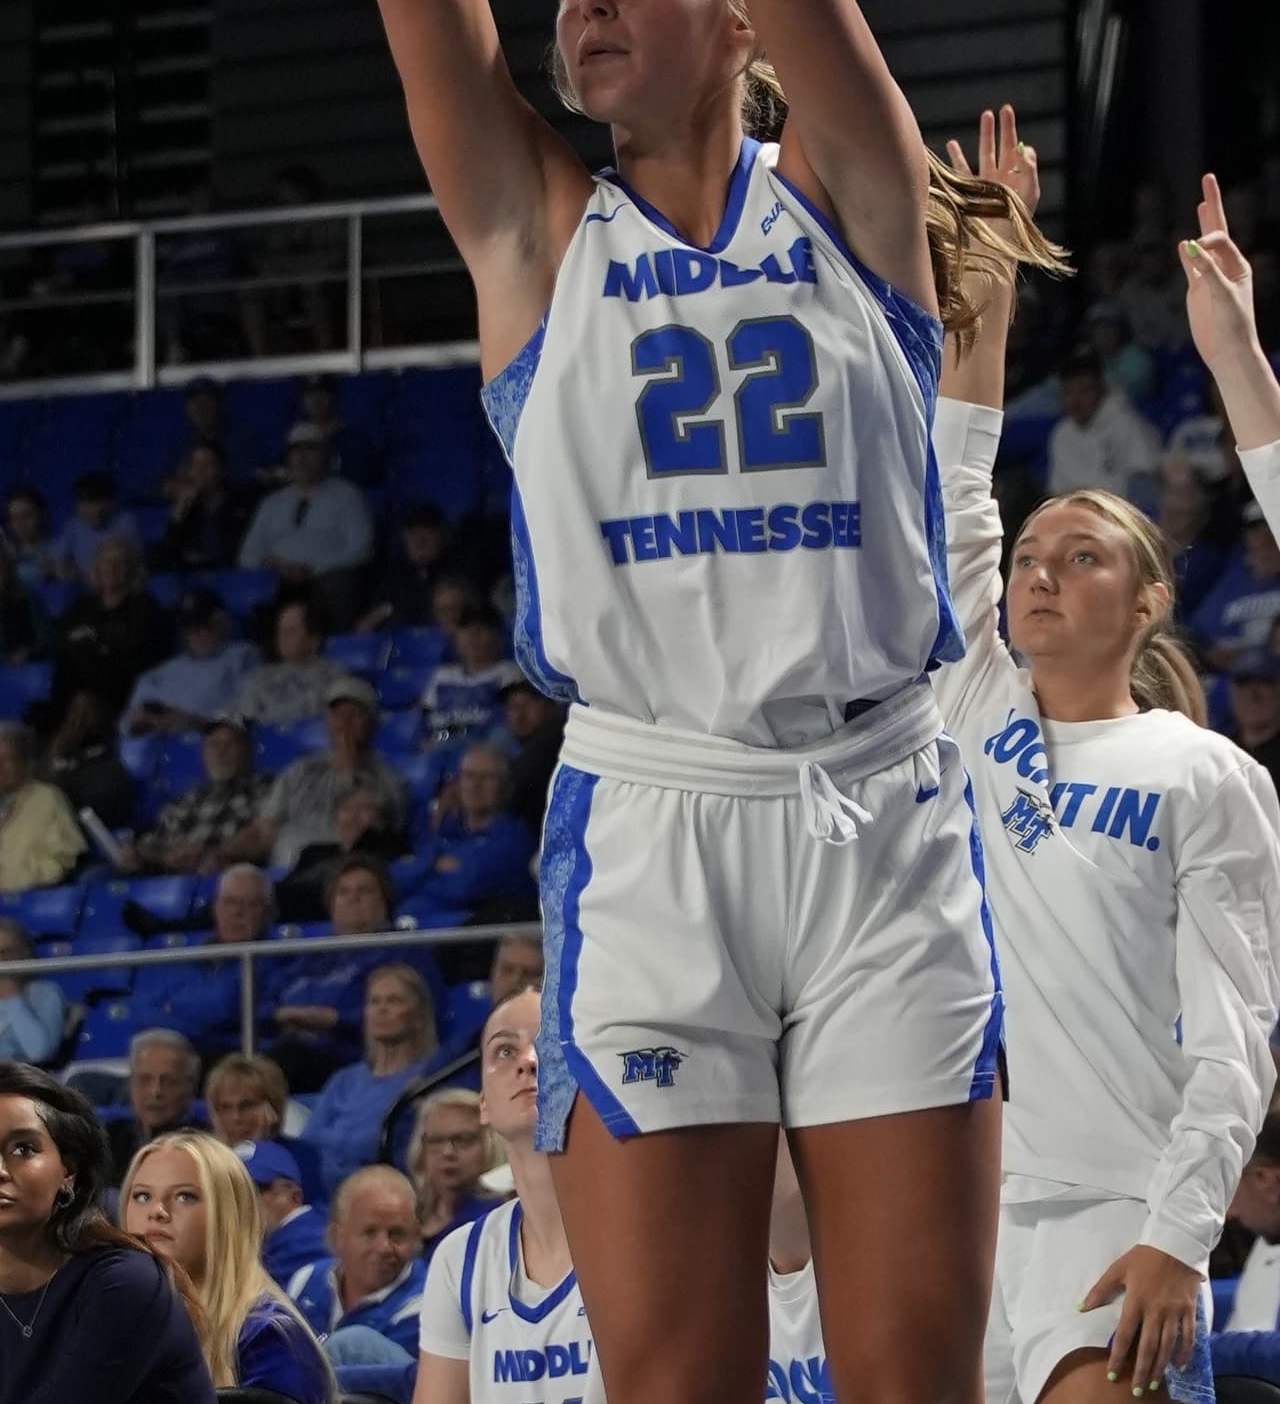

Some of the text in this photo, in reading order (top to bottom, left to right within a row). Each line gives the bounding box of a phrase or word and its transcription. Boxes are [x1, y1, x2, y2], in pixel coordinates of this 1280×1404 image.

[631, 314, 828, 481] 22
[600, 501, 862, 568] TENNESSEE
[1090, 785, 1162, 853] IN.
[493, 1339, 593, 1384] MIDDL
